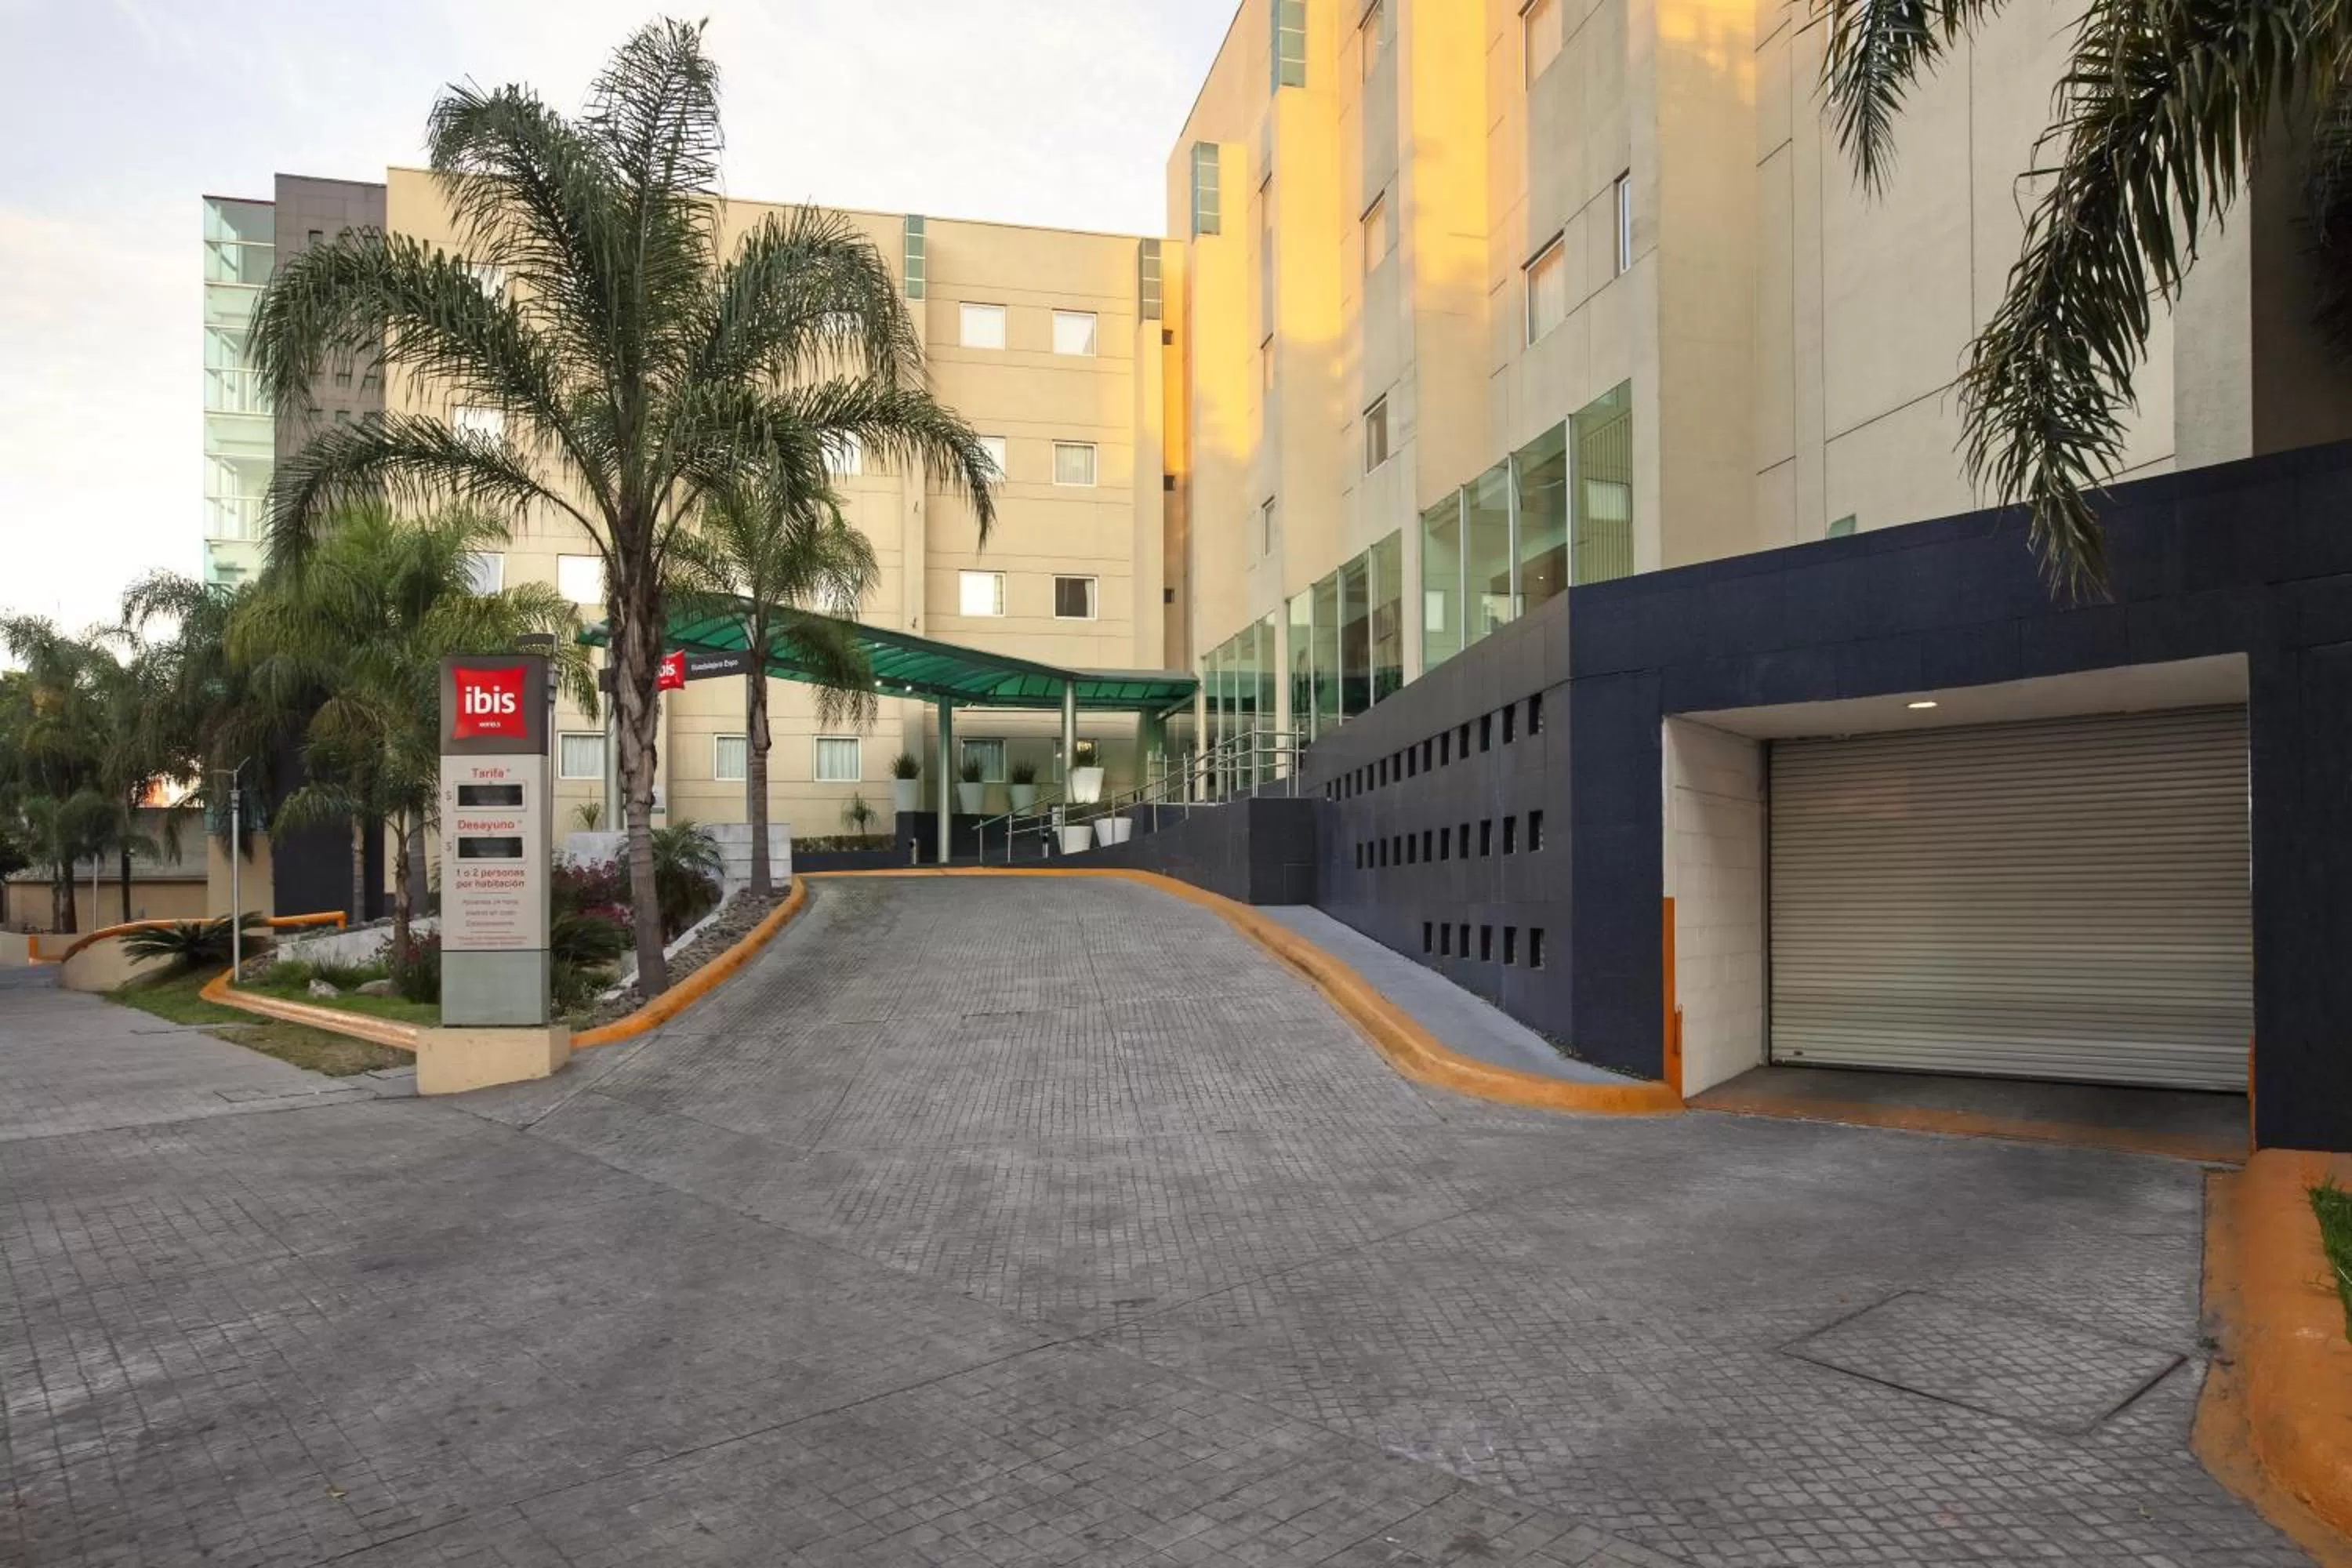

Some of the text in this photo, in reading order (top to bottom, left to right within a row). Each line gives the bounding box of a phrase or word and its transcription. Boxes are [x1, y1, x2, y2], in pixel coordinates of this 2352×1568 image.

[659, 660, 676, 677] is
[465, 685, 516, 714] ibis
[471, 768, 504, 778] Tarifa
[457, 820, 515, 831] Desayuno
[481, 869, 525, 878] personas
[456, 880, 525, 889] por habitación
